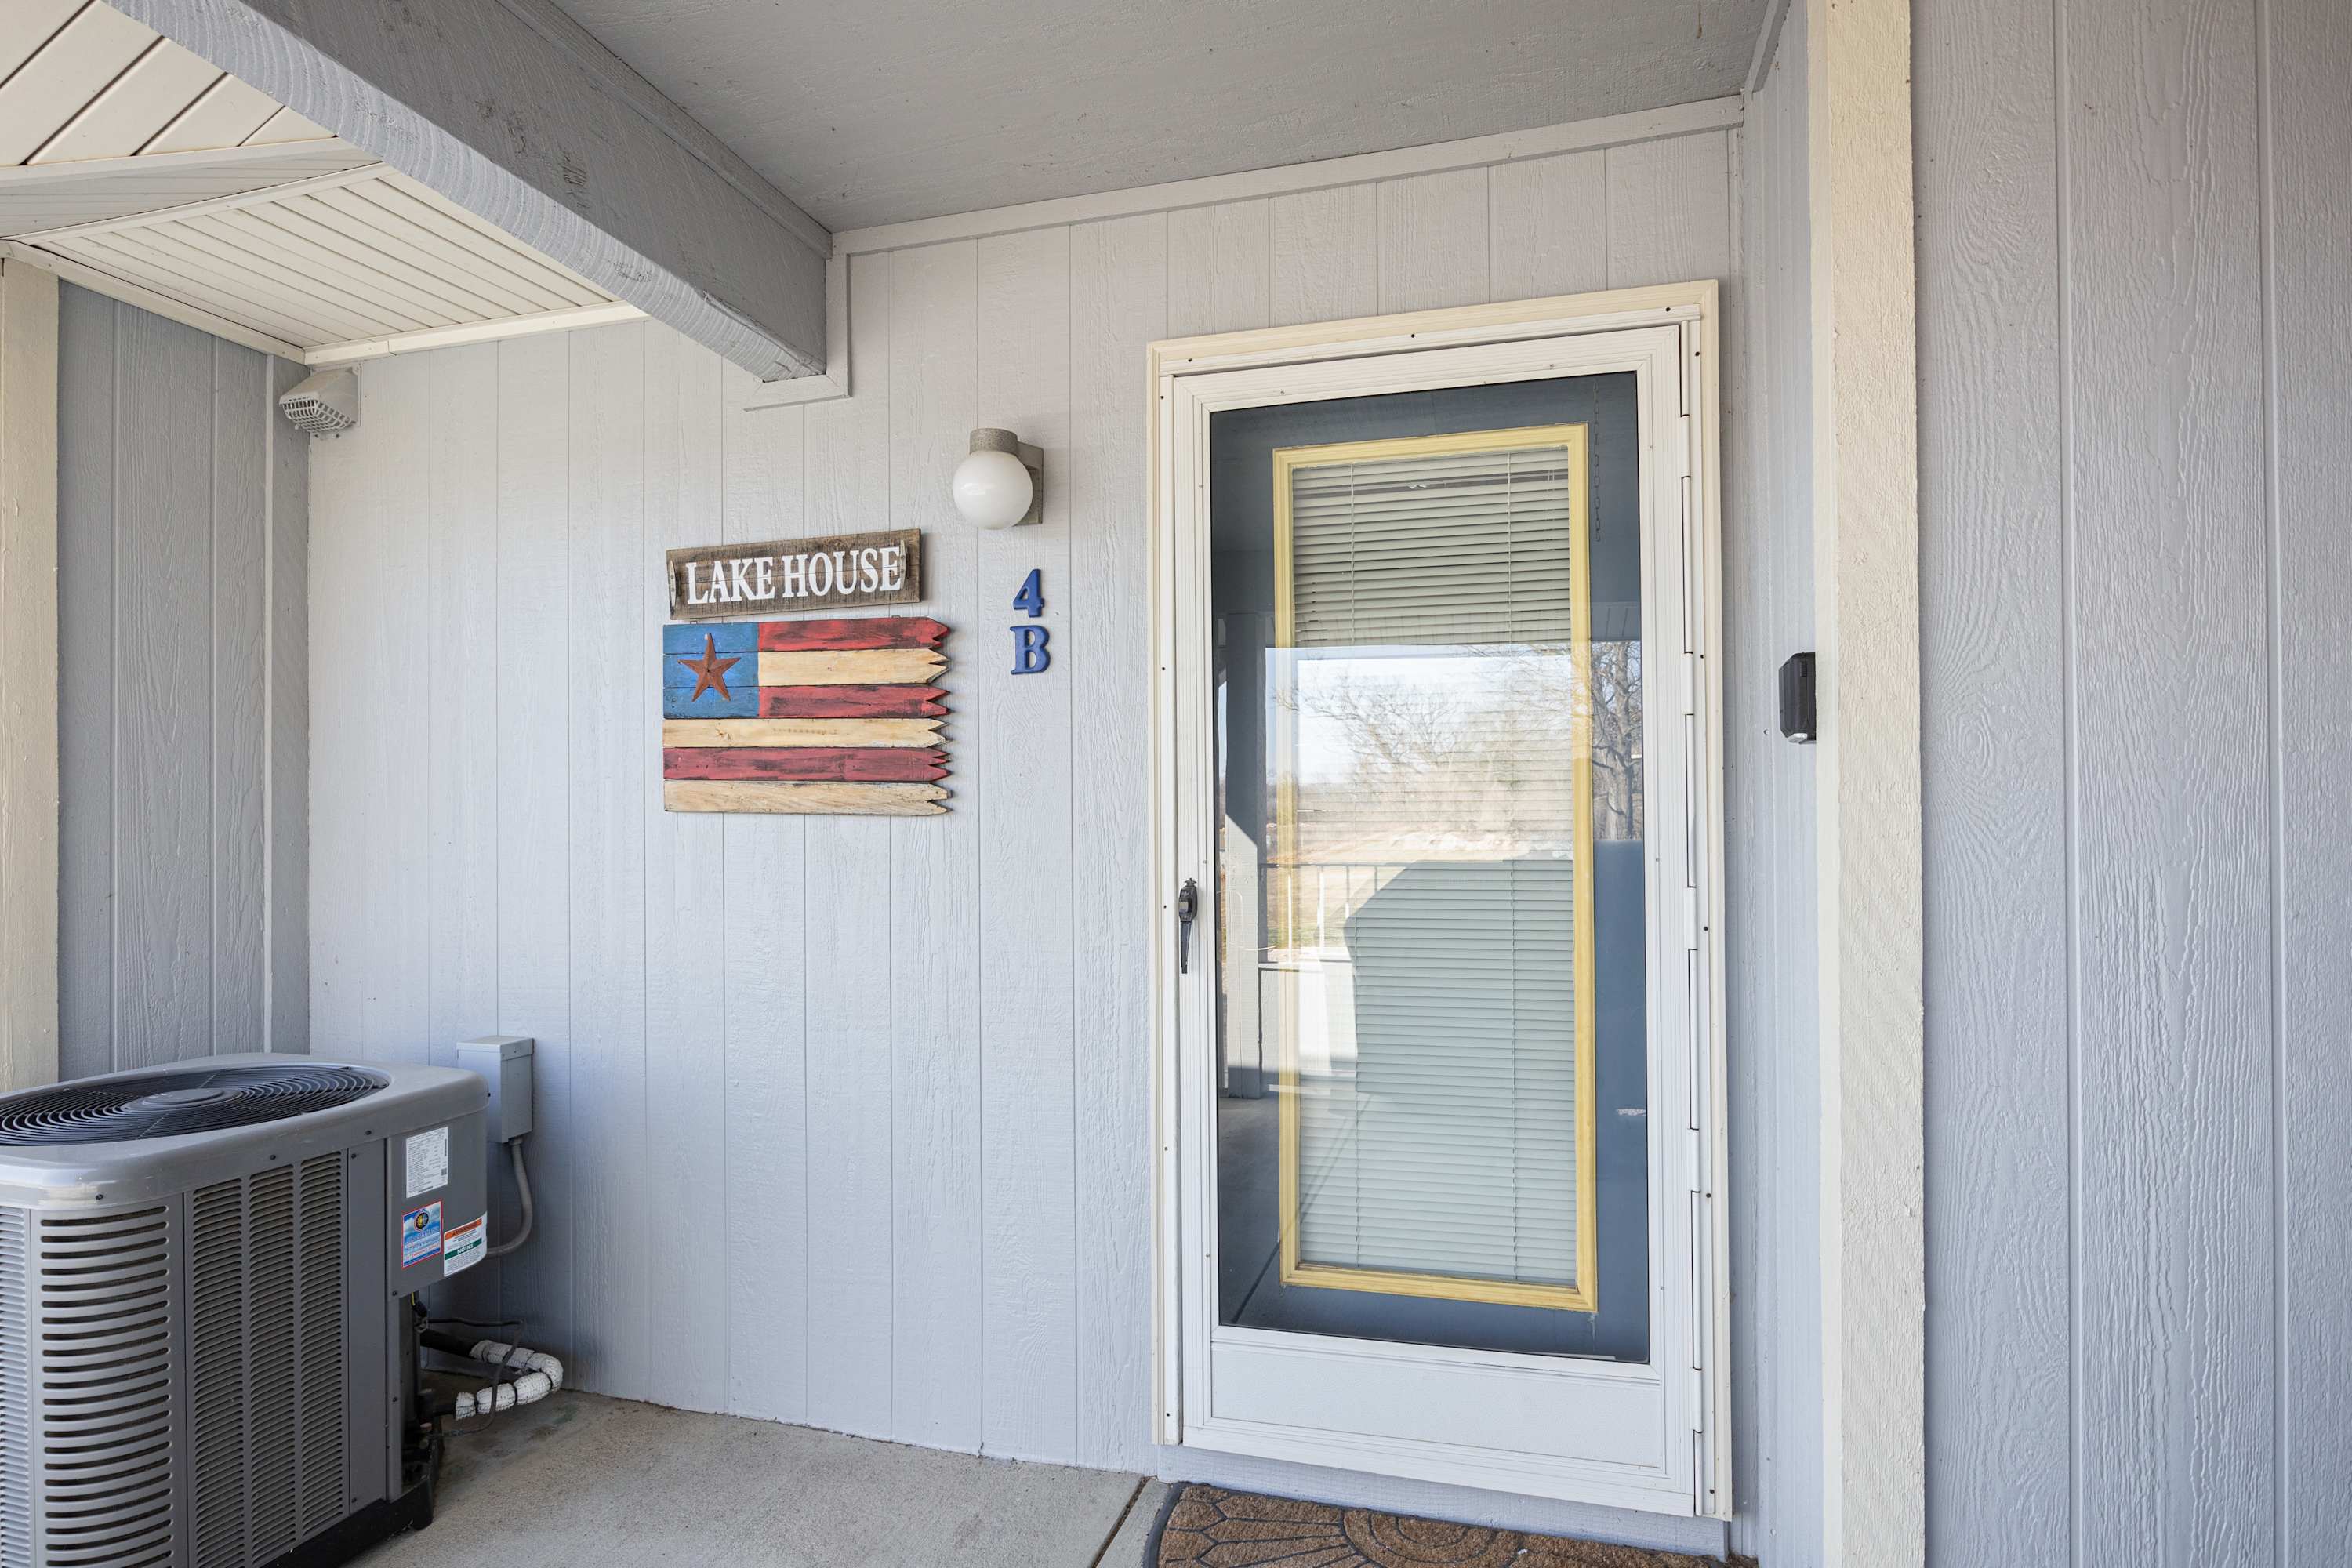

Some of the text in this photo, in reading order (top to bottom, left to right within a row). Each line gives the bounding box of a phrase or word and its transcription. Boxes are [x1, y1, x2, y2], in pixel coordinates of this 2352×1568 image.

[685, 546, 902, 605] LAKE HOUSE
[1013, 568, 1045, 618] 4
[1009, 625, 1051, 675] B
[457, 1243, 474, 1254] NOTICE
